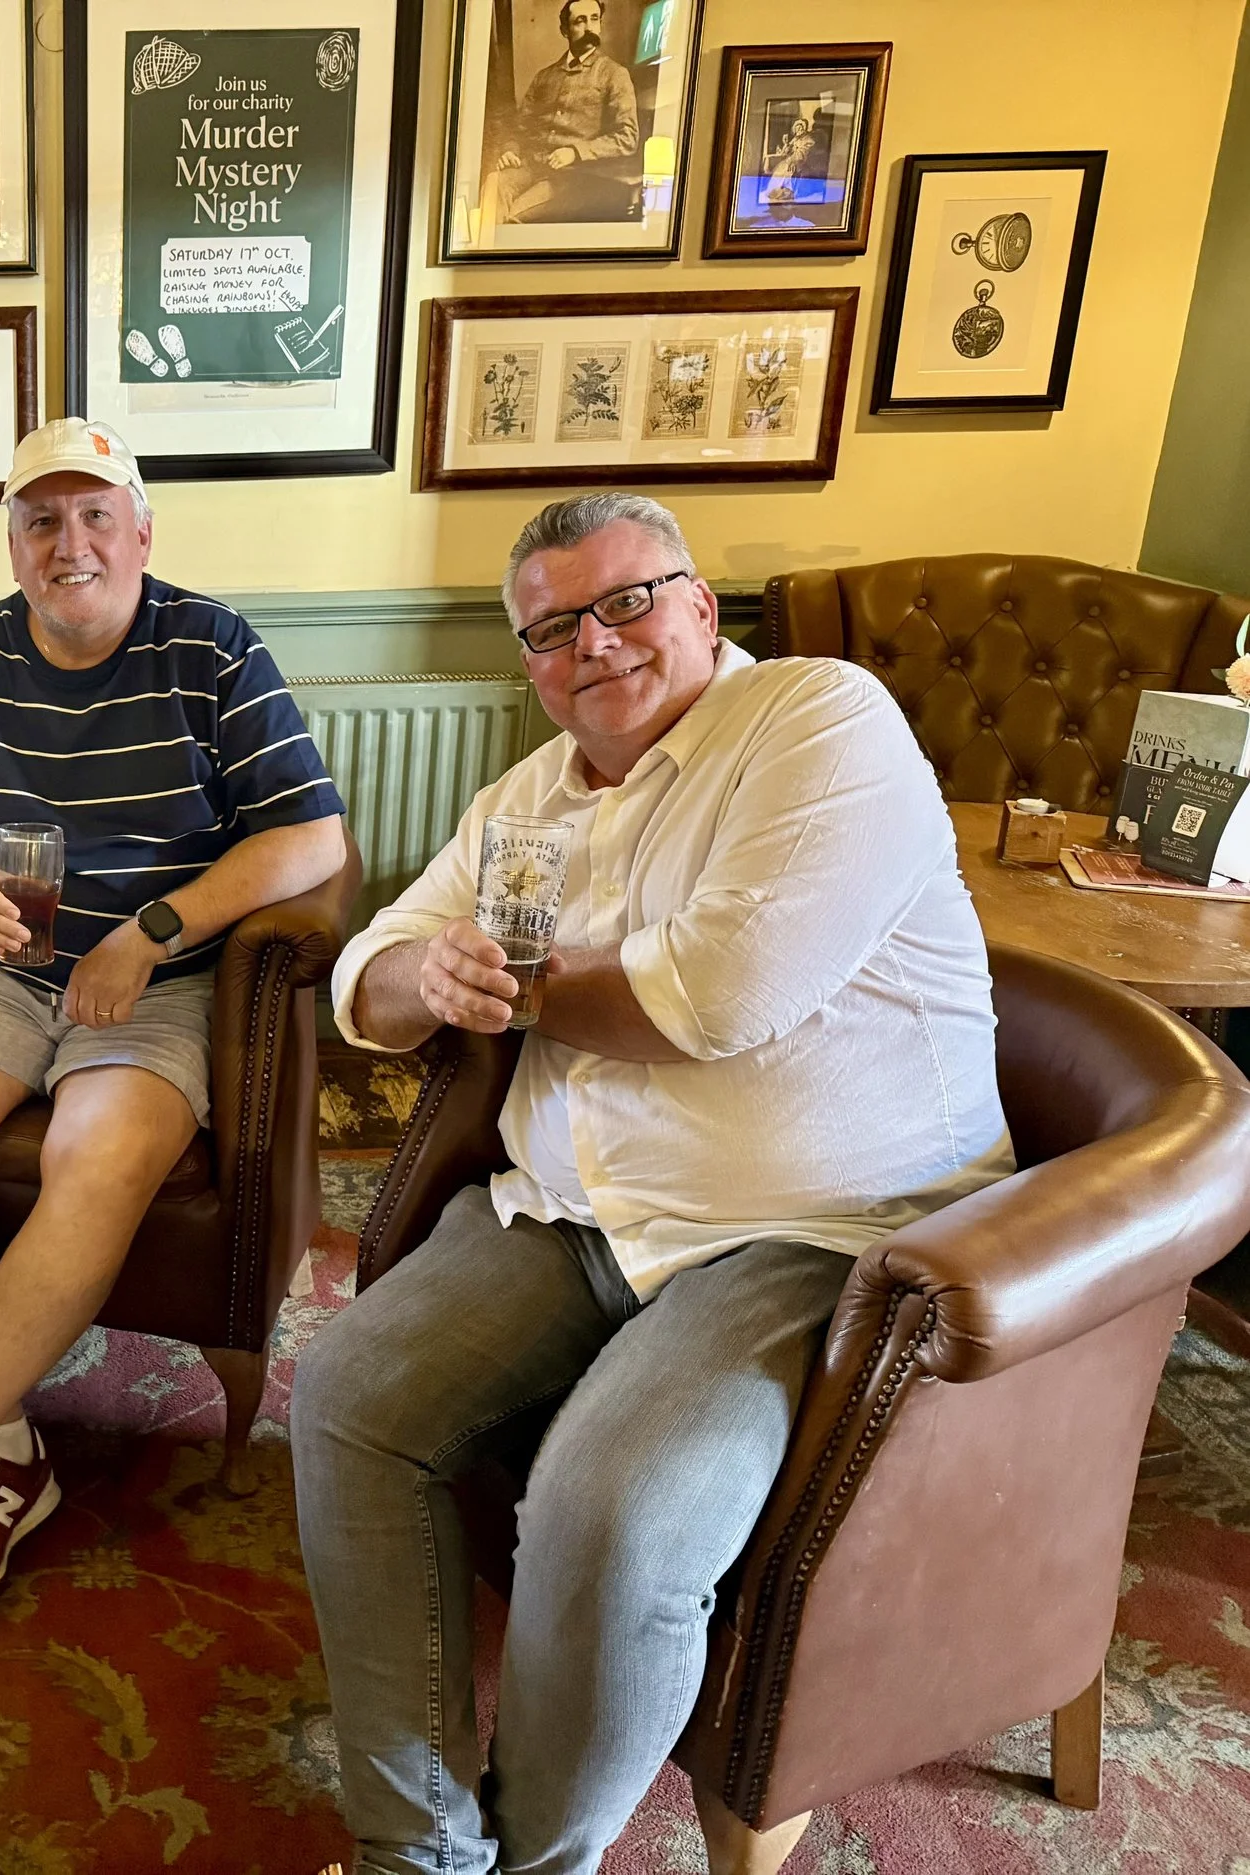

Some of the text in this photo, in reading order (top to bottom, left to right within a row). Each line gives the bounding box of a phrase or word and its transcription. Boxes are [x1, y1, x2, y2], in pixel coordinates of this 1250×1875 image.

[215, 76, 267, 92] Join us
[188, 94, 294, 113] for our charity
[180, 115, 300, 149] Murder
[175, 156, 302, 195] Mystery
[193, 190, 282, 232] Night
[168, 247, 233, 261] SATURDAY
[264, 247, 294, 261] OCT.
[163, 268, 206, 278] LIMITED
[213, 265, 243, 276] SPOTS
[163, 277, 285, 293] RAISING MONEY FOR
[165, 295, 209, 305] CHASING
[1134, 730, 1187, 751] DRINKS
[1150, 776, 1169, 786] BU
[1176, 777, 1195, 788] FROM
[1195, 781, 1212, 793] YOUR
[1212, 785, 1232, 798] TABLE
[1183, 768, 1235, 790] Order & Pay
